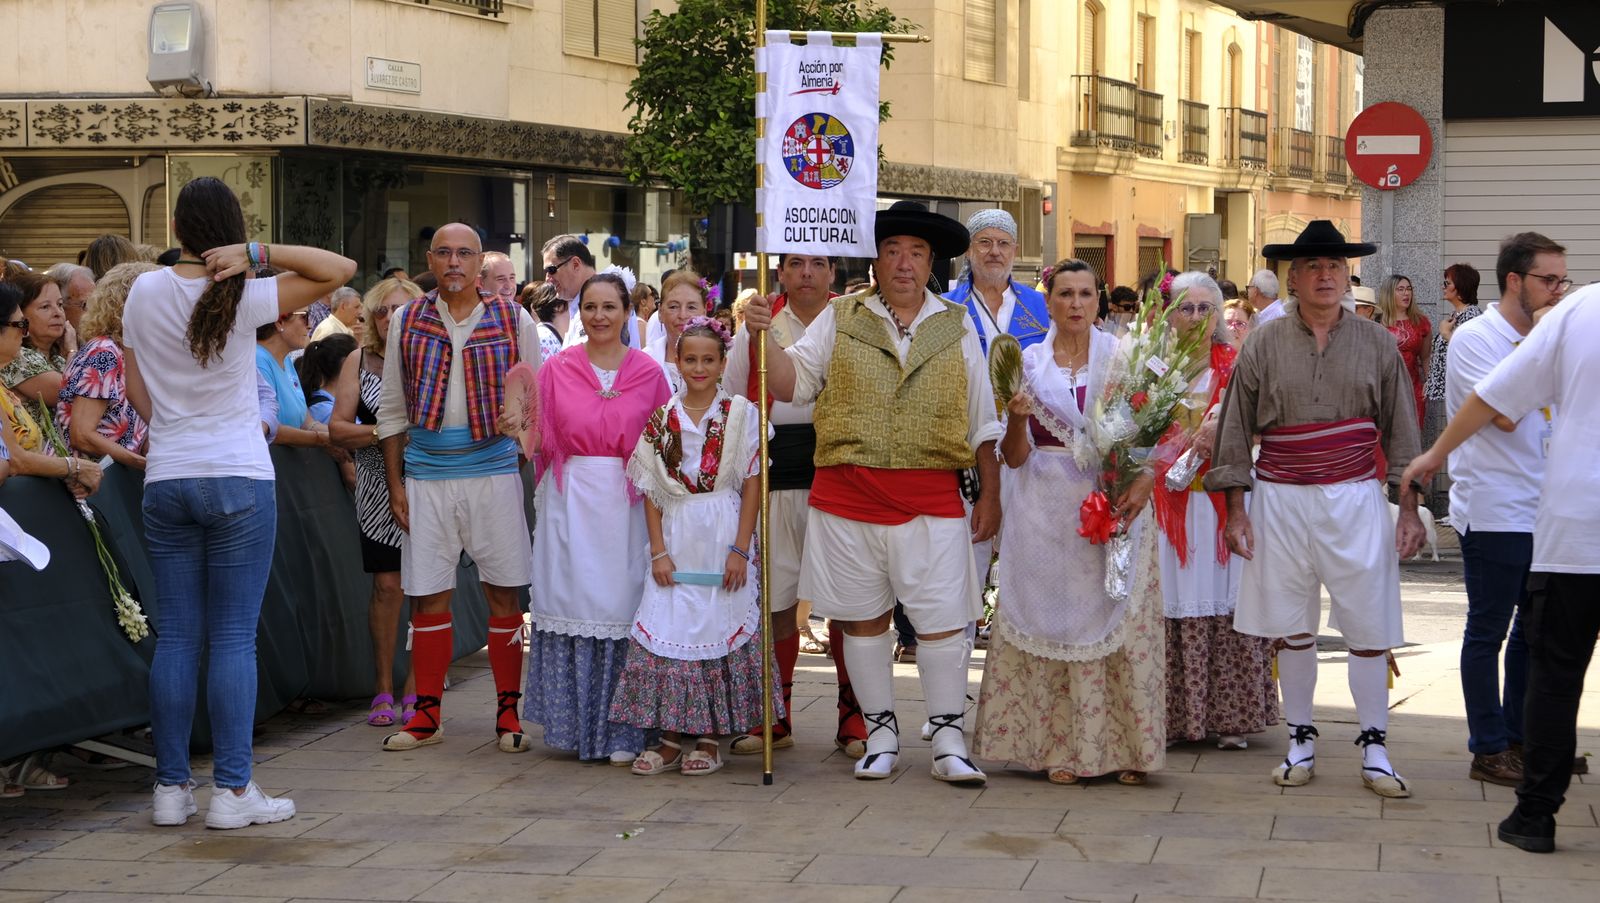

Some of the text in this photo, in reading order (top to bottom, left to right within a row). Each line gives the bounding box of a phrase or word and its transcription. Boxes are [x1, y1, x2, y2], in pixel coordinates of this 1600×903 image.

[387, 64, 403, 72] CALLE
[798, 60, 844, 76] Acción por
[784, 207, 857, 225] ASOCIACION
[784, 226, 858, 244] CULTURAL
